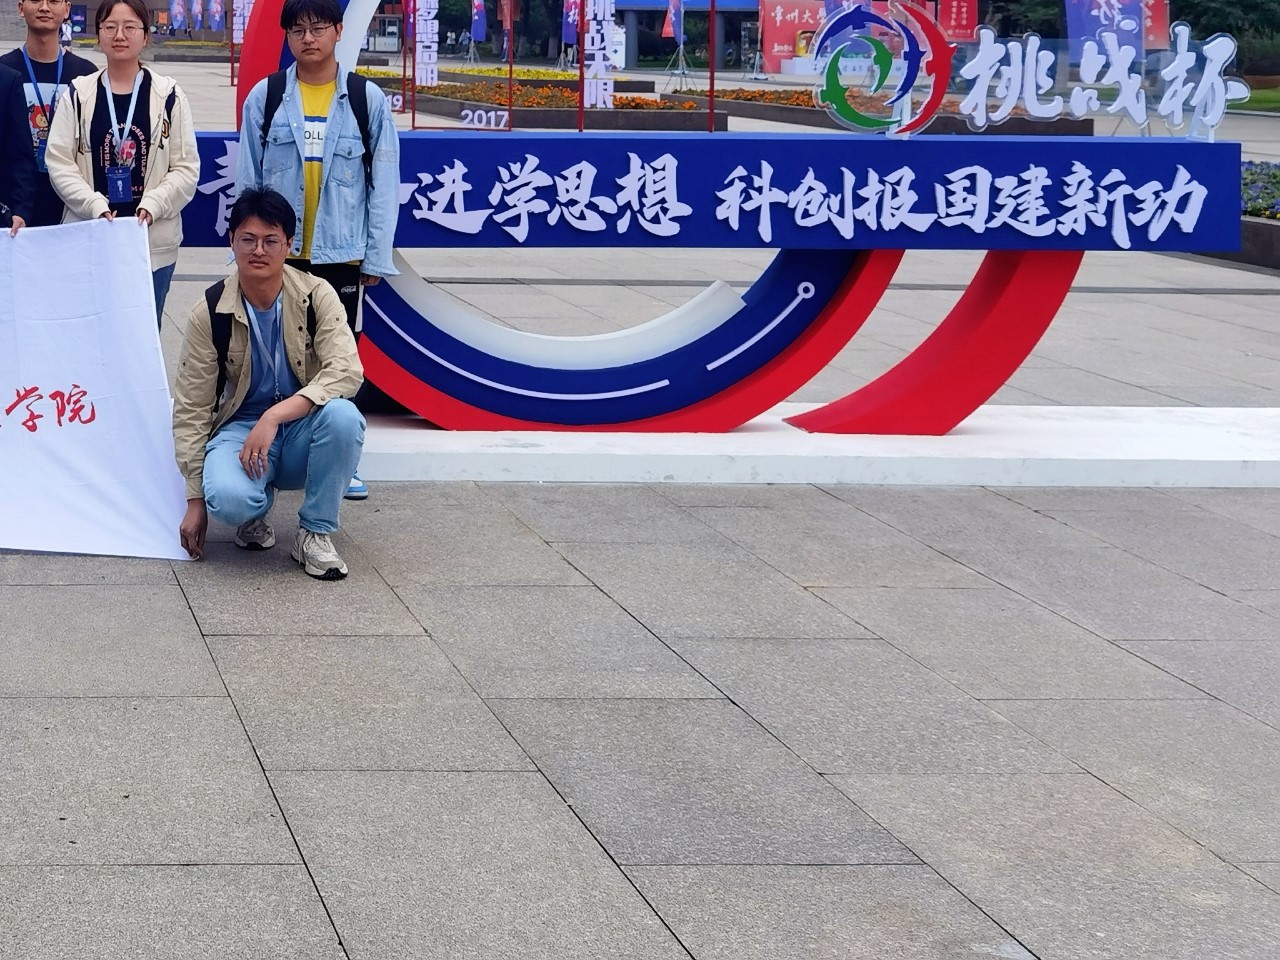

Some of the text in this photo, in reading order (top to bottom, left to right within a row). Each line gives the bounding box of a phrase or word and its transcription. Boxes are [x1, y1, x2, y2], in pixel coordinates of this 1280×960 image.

[959, 20, 1250, 128] 挑战杯
[460, 109, 510, 129] 2017
[714, 160, 1208, 248] 科创报国建新功
